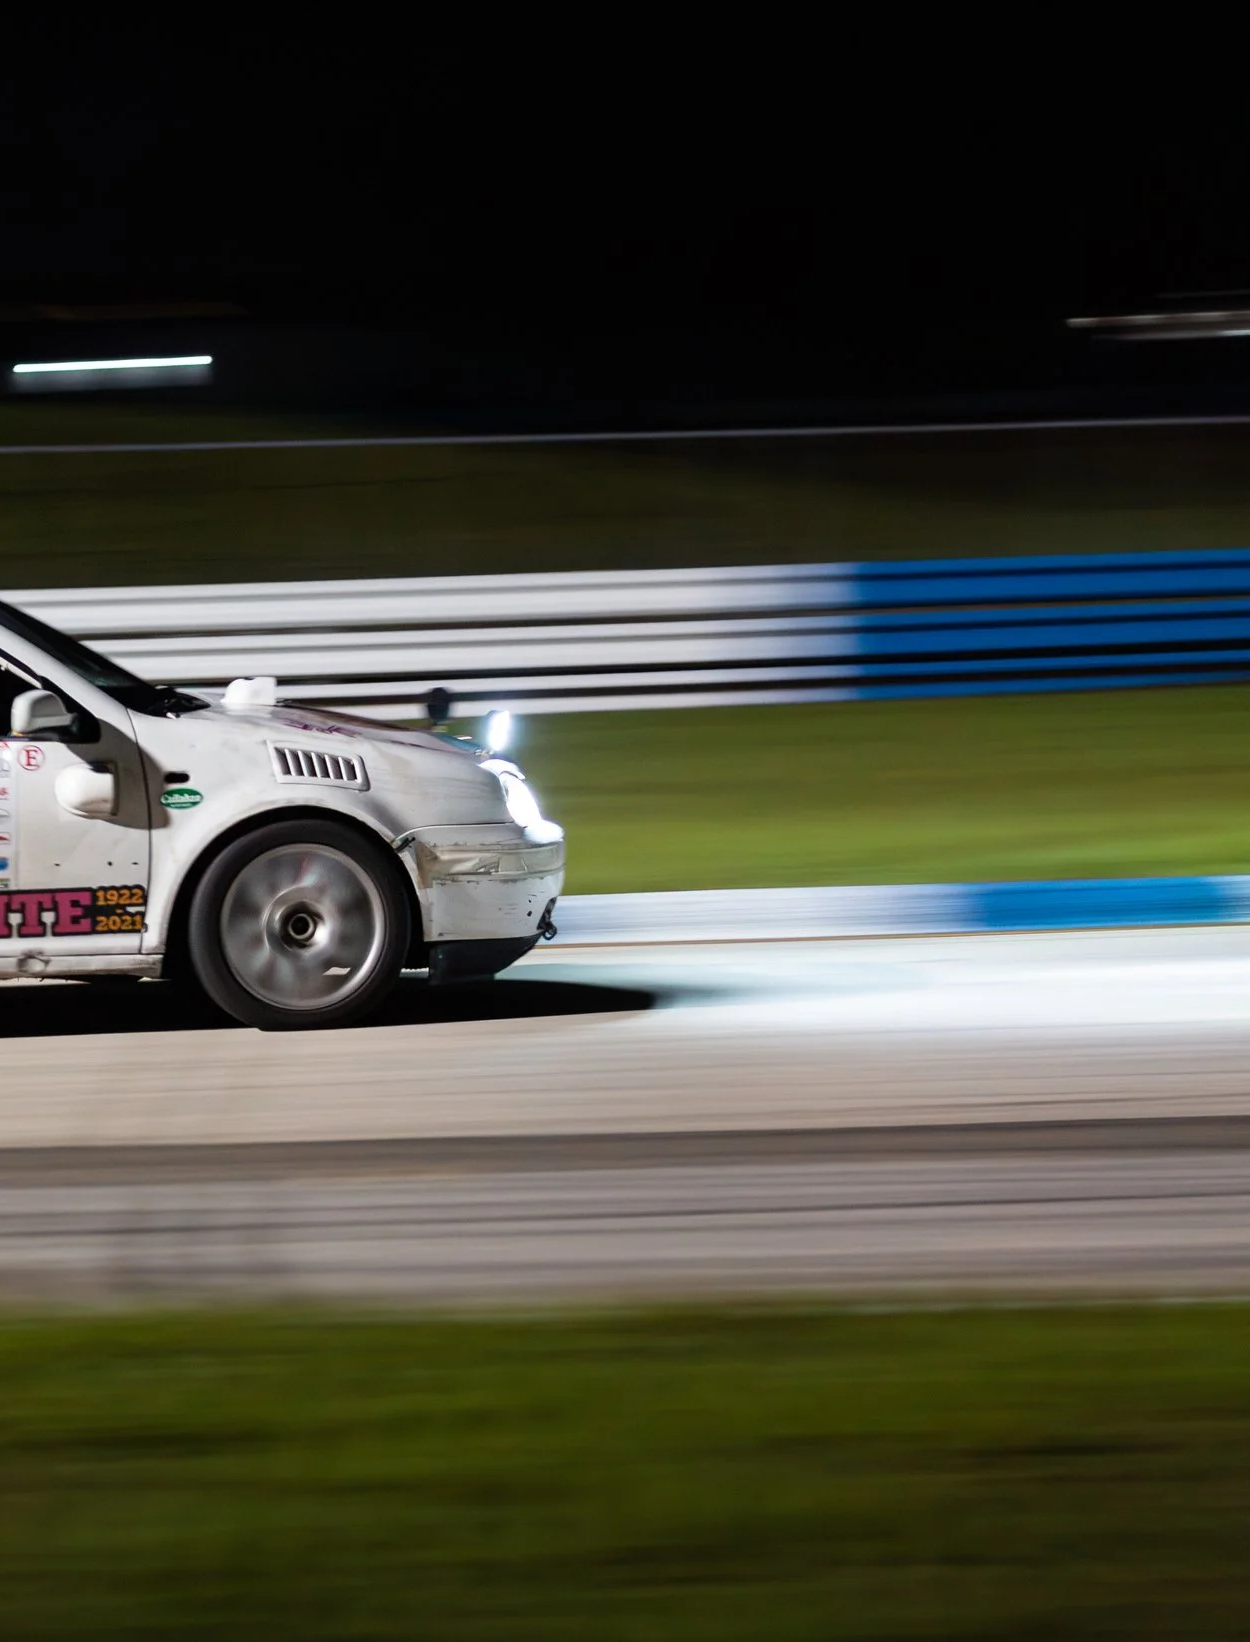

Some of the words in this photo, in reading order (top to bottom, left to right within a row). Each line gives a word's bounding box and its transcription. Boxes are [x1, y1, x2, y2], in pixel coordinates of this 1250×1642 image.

[25, 749, 41, 767] E
[96, 889, 143, 906] 1922
[96, 914, 143, 931] 2021
